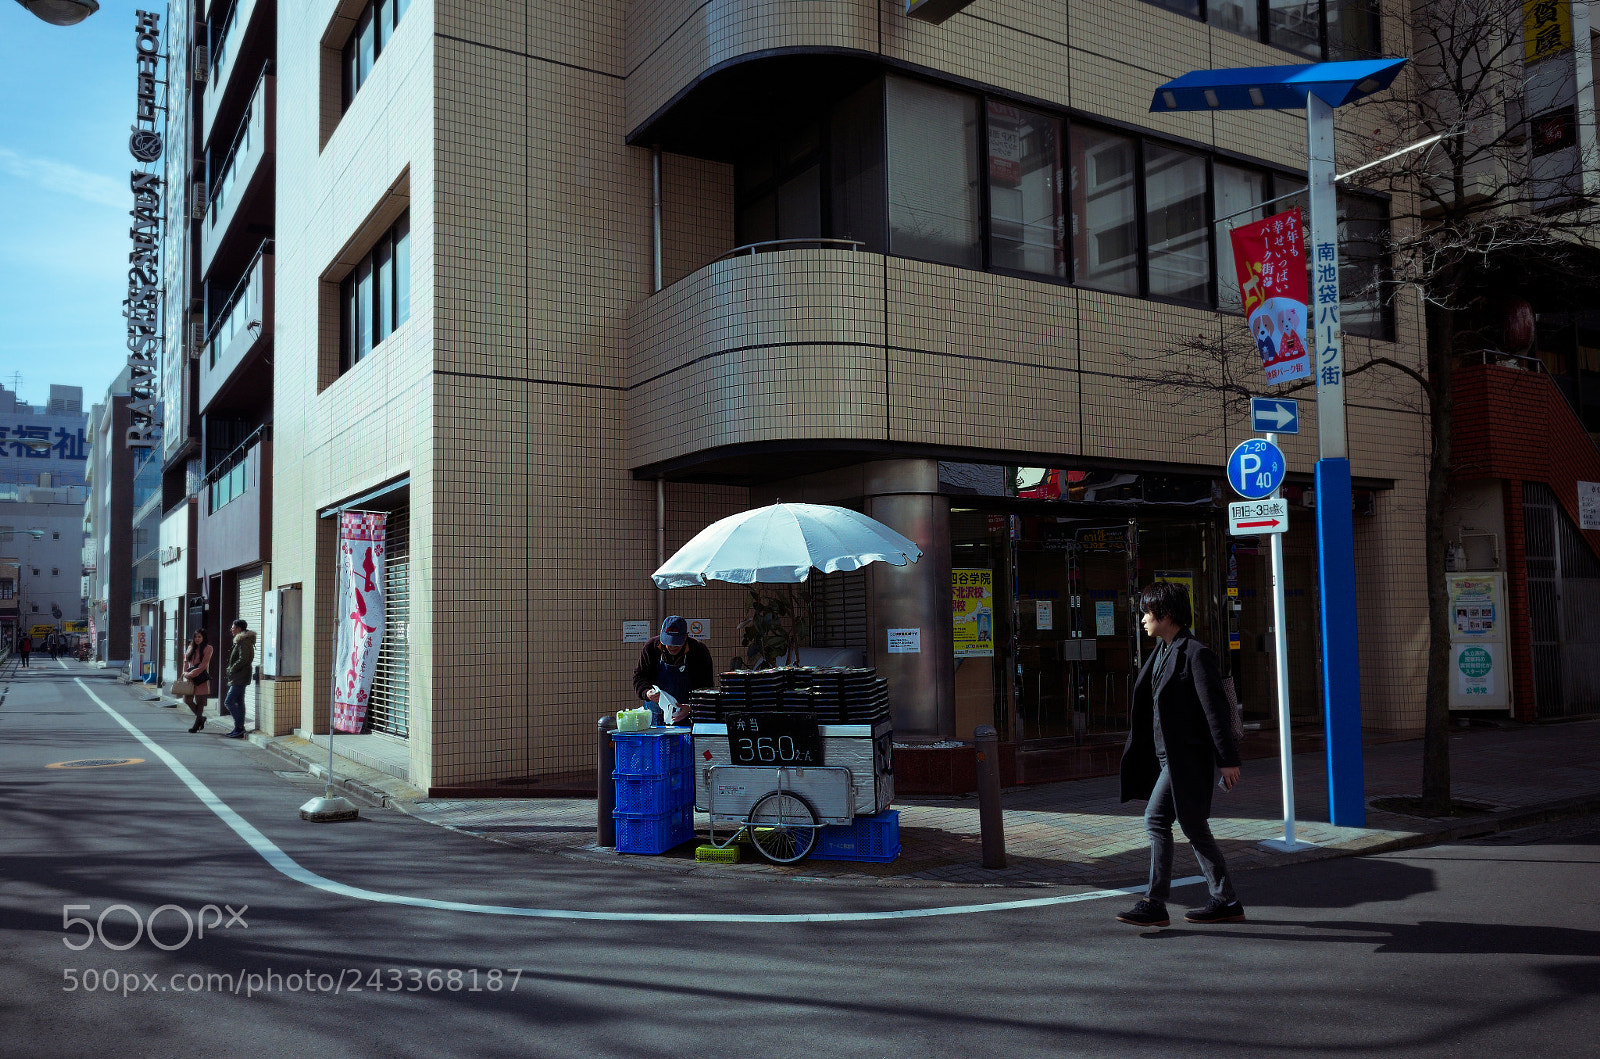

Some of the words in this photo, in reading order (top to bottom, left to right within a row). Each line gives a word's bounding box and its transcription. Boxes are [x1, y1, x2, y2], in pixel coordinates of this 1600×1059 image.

[135, 9, 160, 121] HOTEL
[132, 170, 157, 268] SEVEN
[1285, 216, 1299, 257] 今年も
[1260, 223, 1275, 276] パーク街
[1272, 221, 1288, 293] 幸せいっぱい
[1317, 242, 1340, 385] 南池袋パーク街
[0, 425, 88, 460] 福祉
[1243, 443, 1266, 454] 7-20
[1240, 454, 1261, 490] P
[1256, 472, 1272, 488] 40
[736, 717, 759, 731] 弁当
